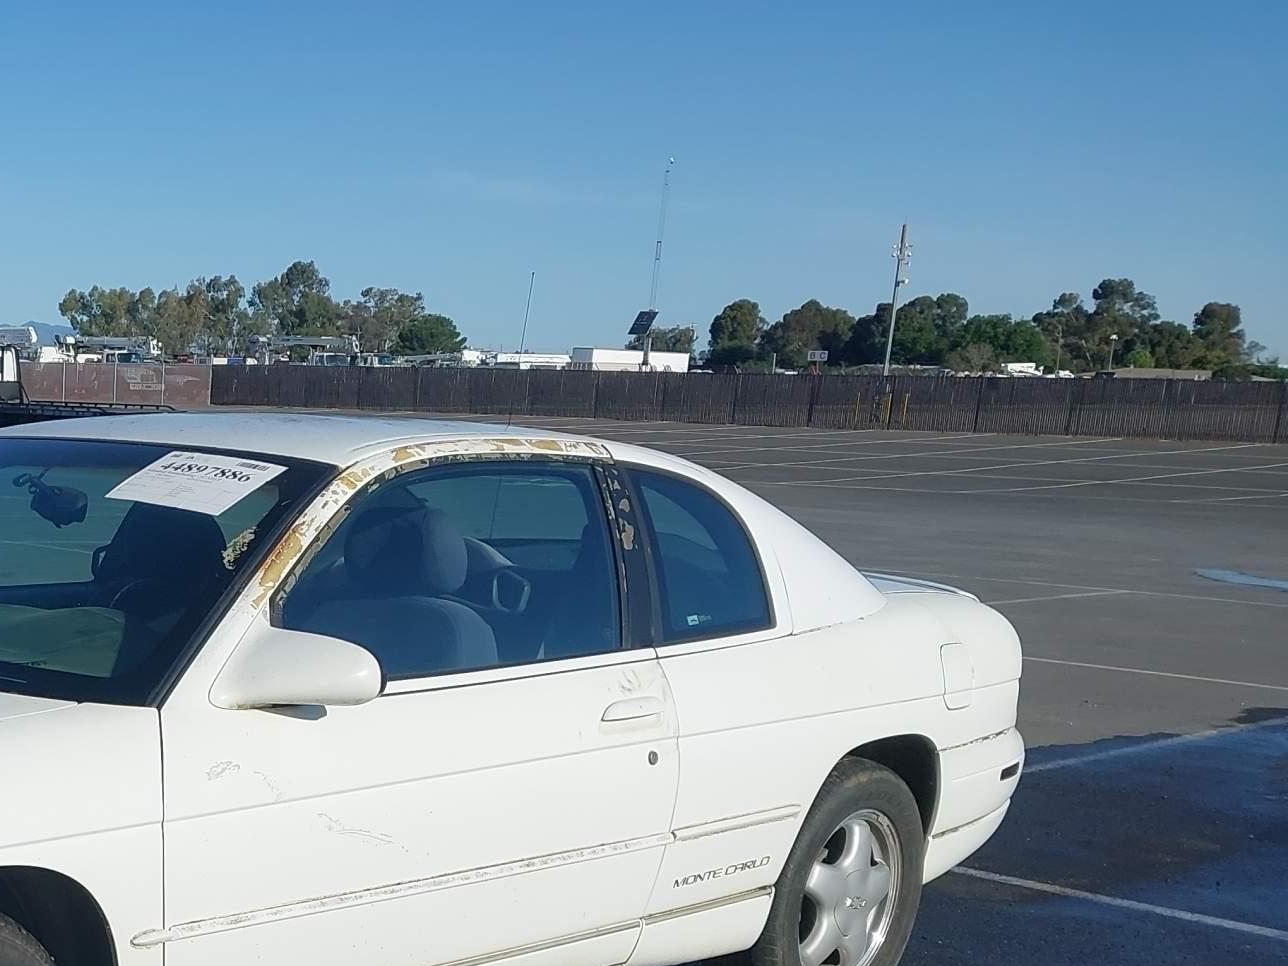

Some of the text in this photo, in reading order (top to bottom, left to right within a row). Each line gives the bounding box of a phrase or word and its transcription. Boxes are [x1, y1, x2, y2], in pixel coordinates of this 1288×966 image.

[820, 352, 826, 360] C
[160, 462, 253, 482] 44897886
[673, 856, 771, 889] MONTE CARLO
